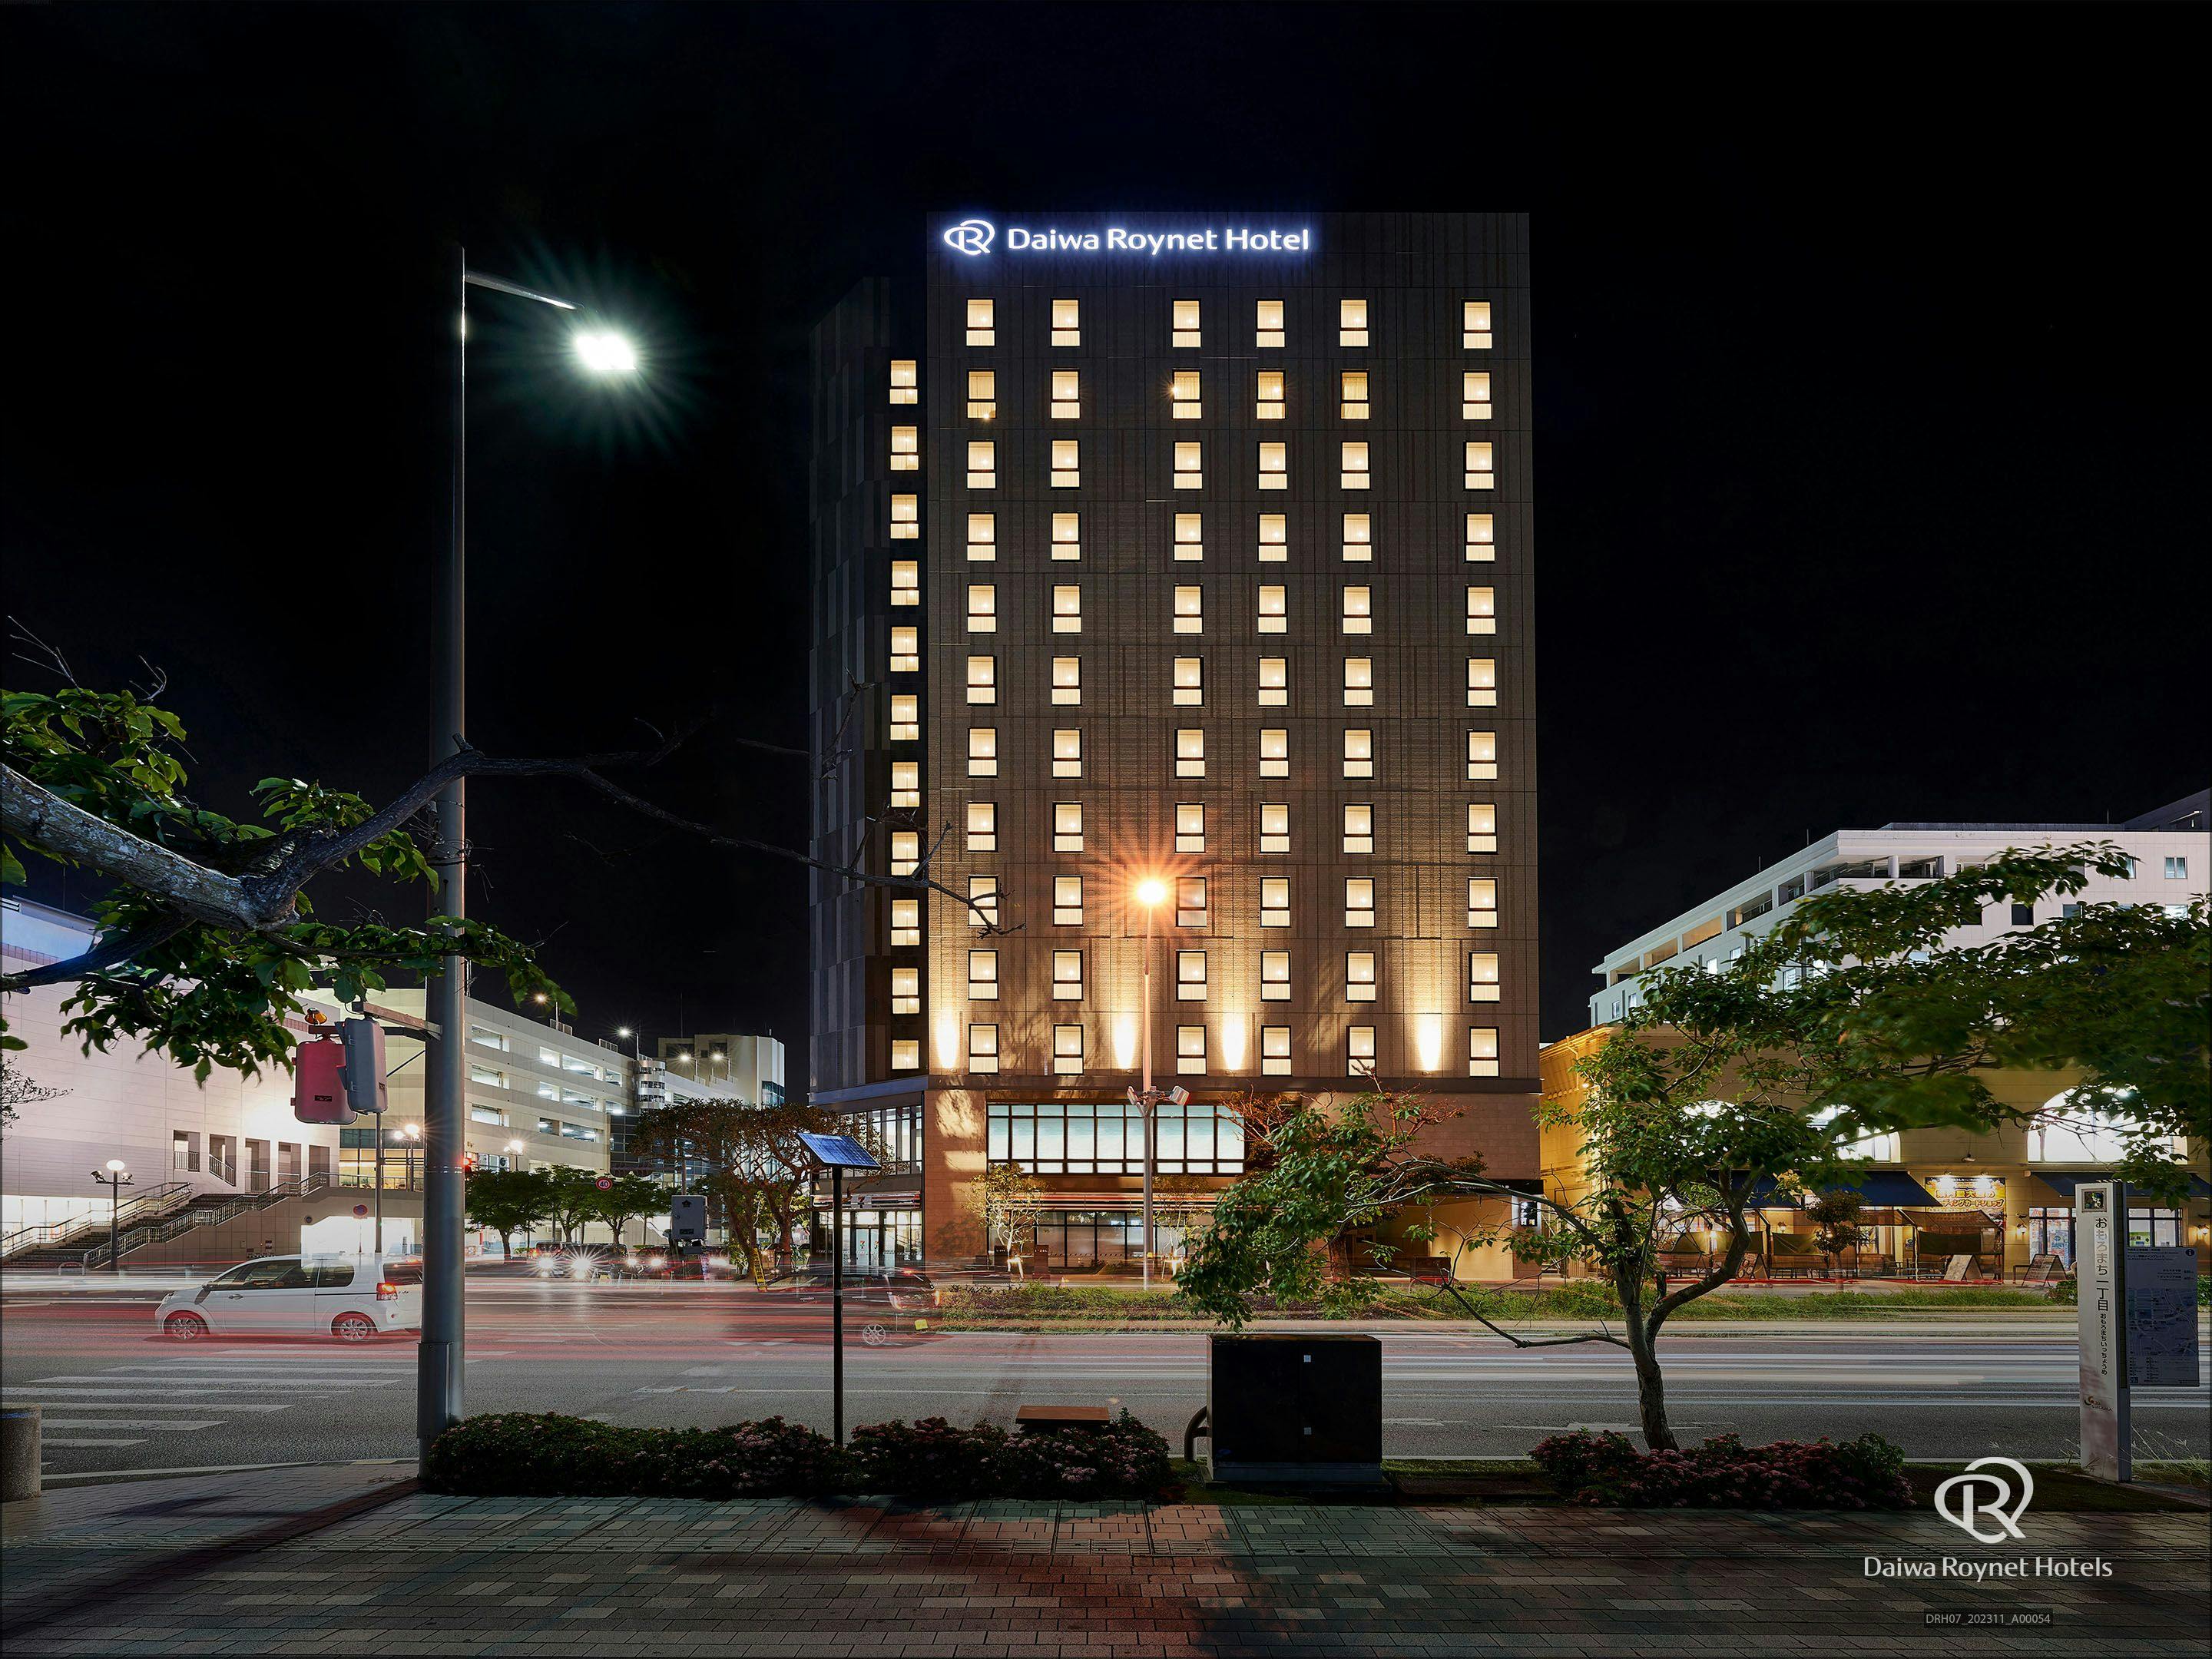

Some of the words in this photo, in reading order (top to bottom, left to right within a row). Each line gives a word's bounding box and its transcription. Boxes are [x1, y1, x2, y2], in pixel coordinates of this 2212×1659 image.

[1008, 228, 1099, 250] Daiwa
[1108, 228, 1218, 255] Roynet
[1227, 229, 1310, 250] Hotel
[2094, 1217, 2110, 1312] おもろまち一丁目
[2100, 1313, 2108, 1376] おもろまちいっちょうめ
